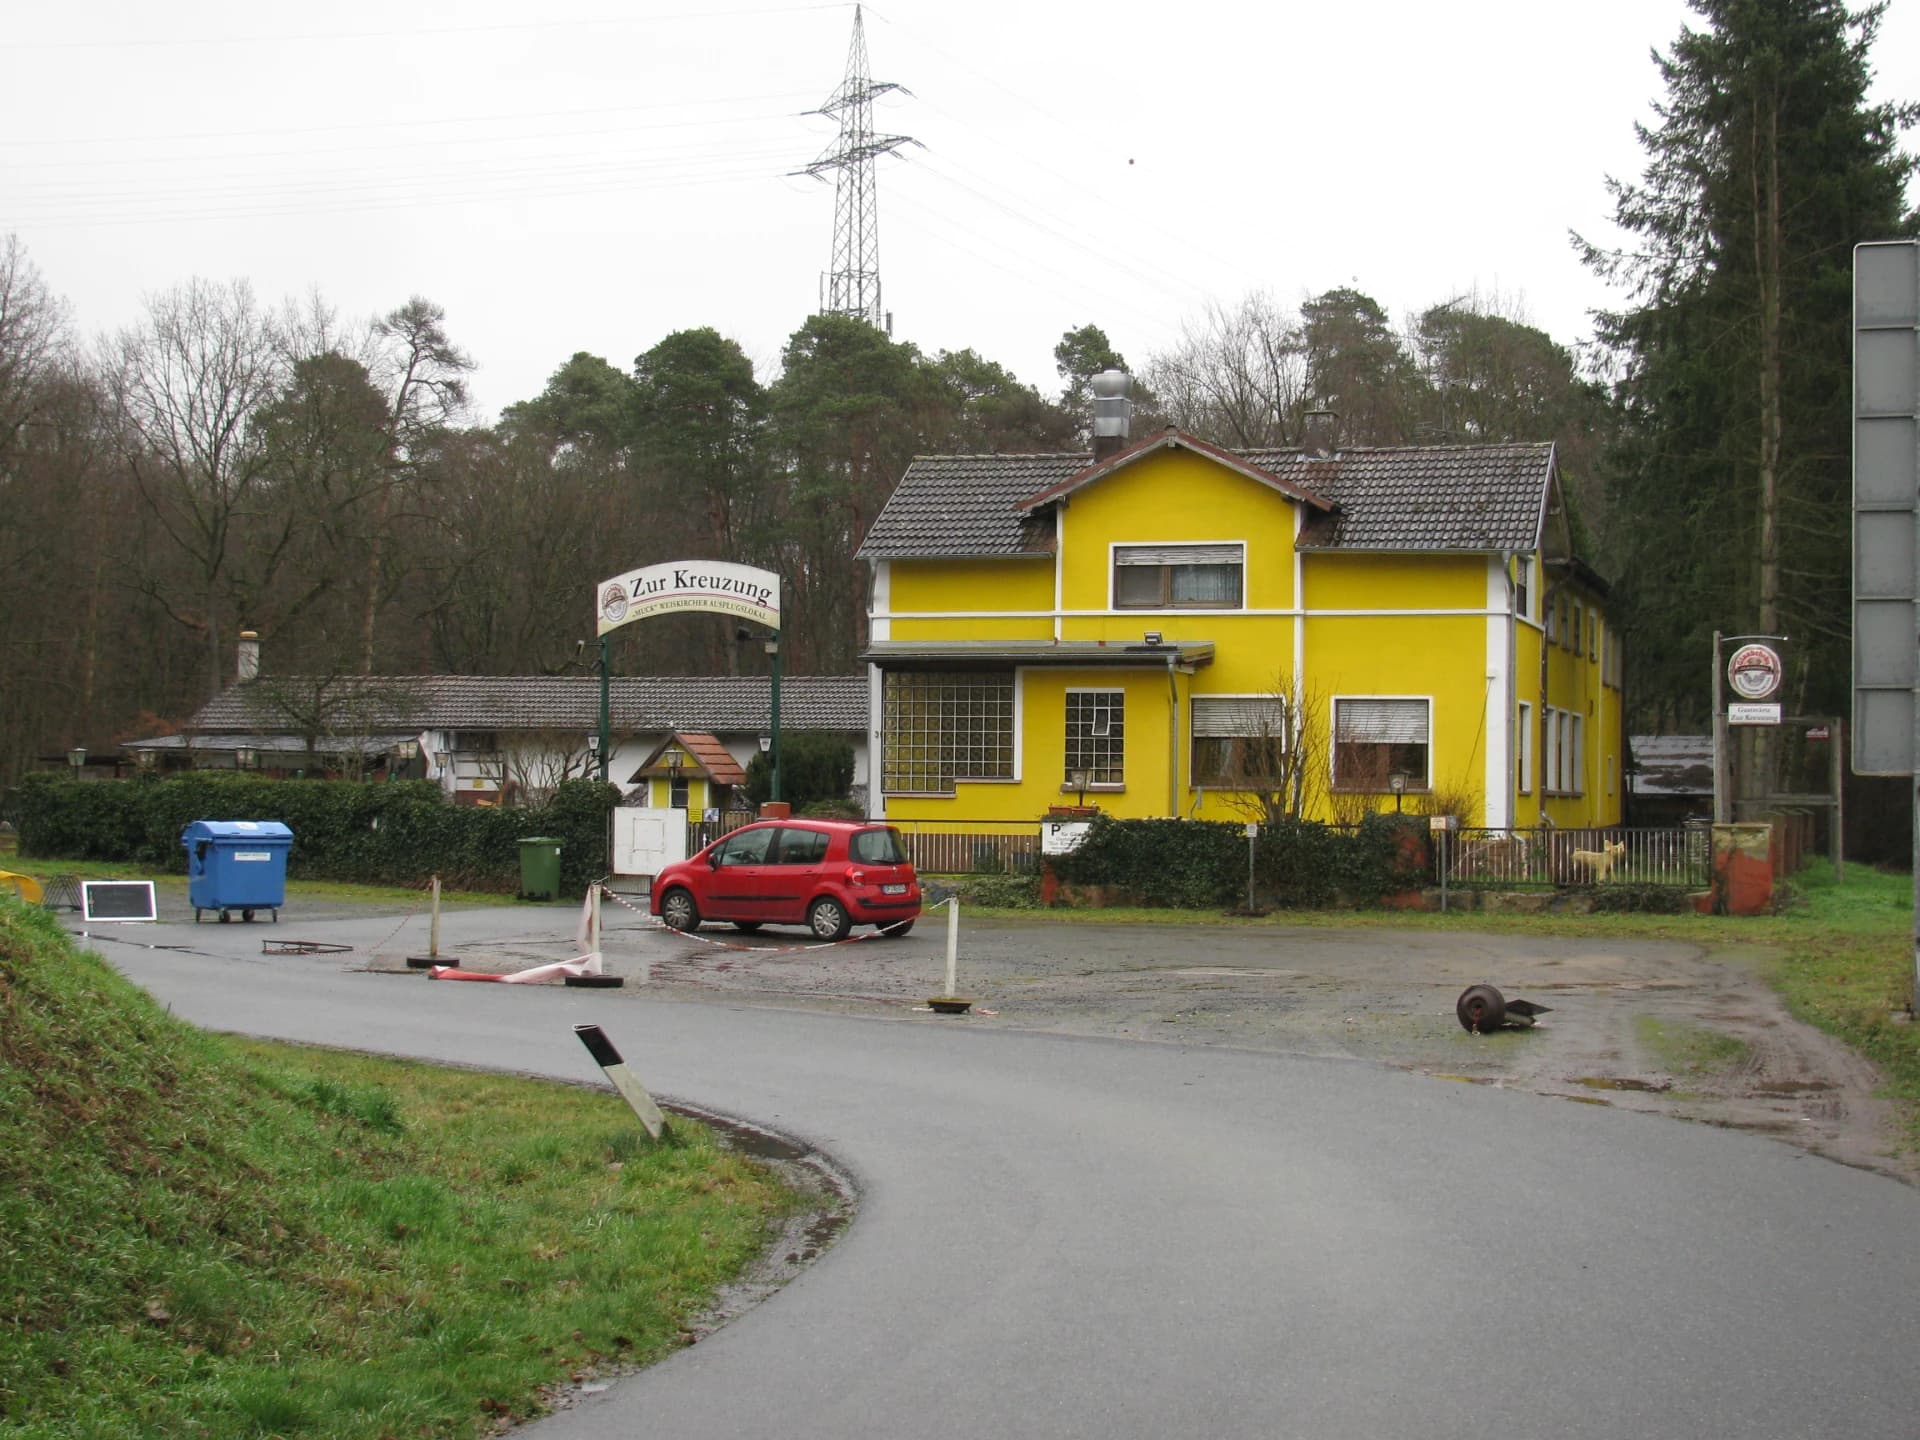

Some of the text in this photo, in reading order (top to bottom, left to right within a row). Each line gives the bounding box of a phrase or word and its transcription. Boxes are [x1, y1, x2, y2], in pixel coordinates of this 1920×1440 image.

[630, 569, 773, 608] Zur Kreuzung
[709, 600, 768, 620] AUSFLUGSLOKAL
[1051, 824, 1061, 836] P
